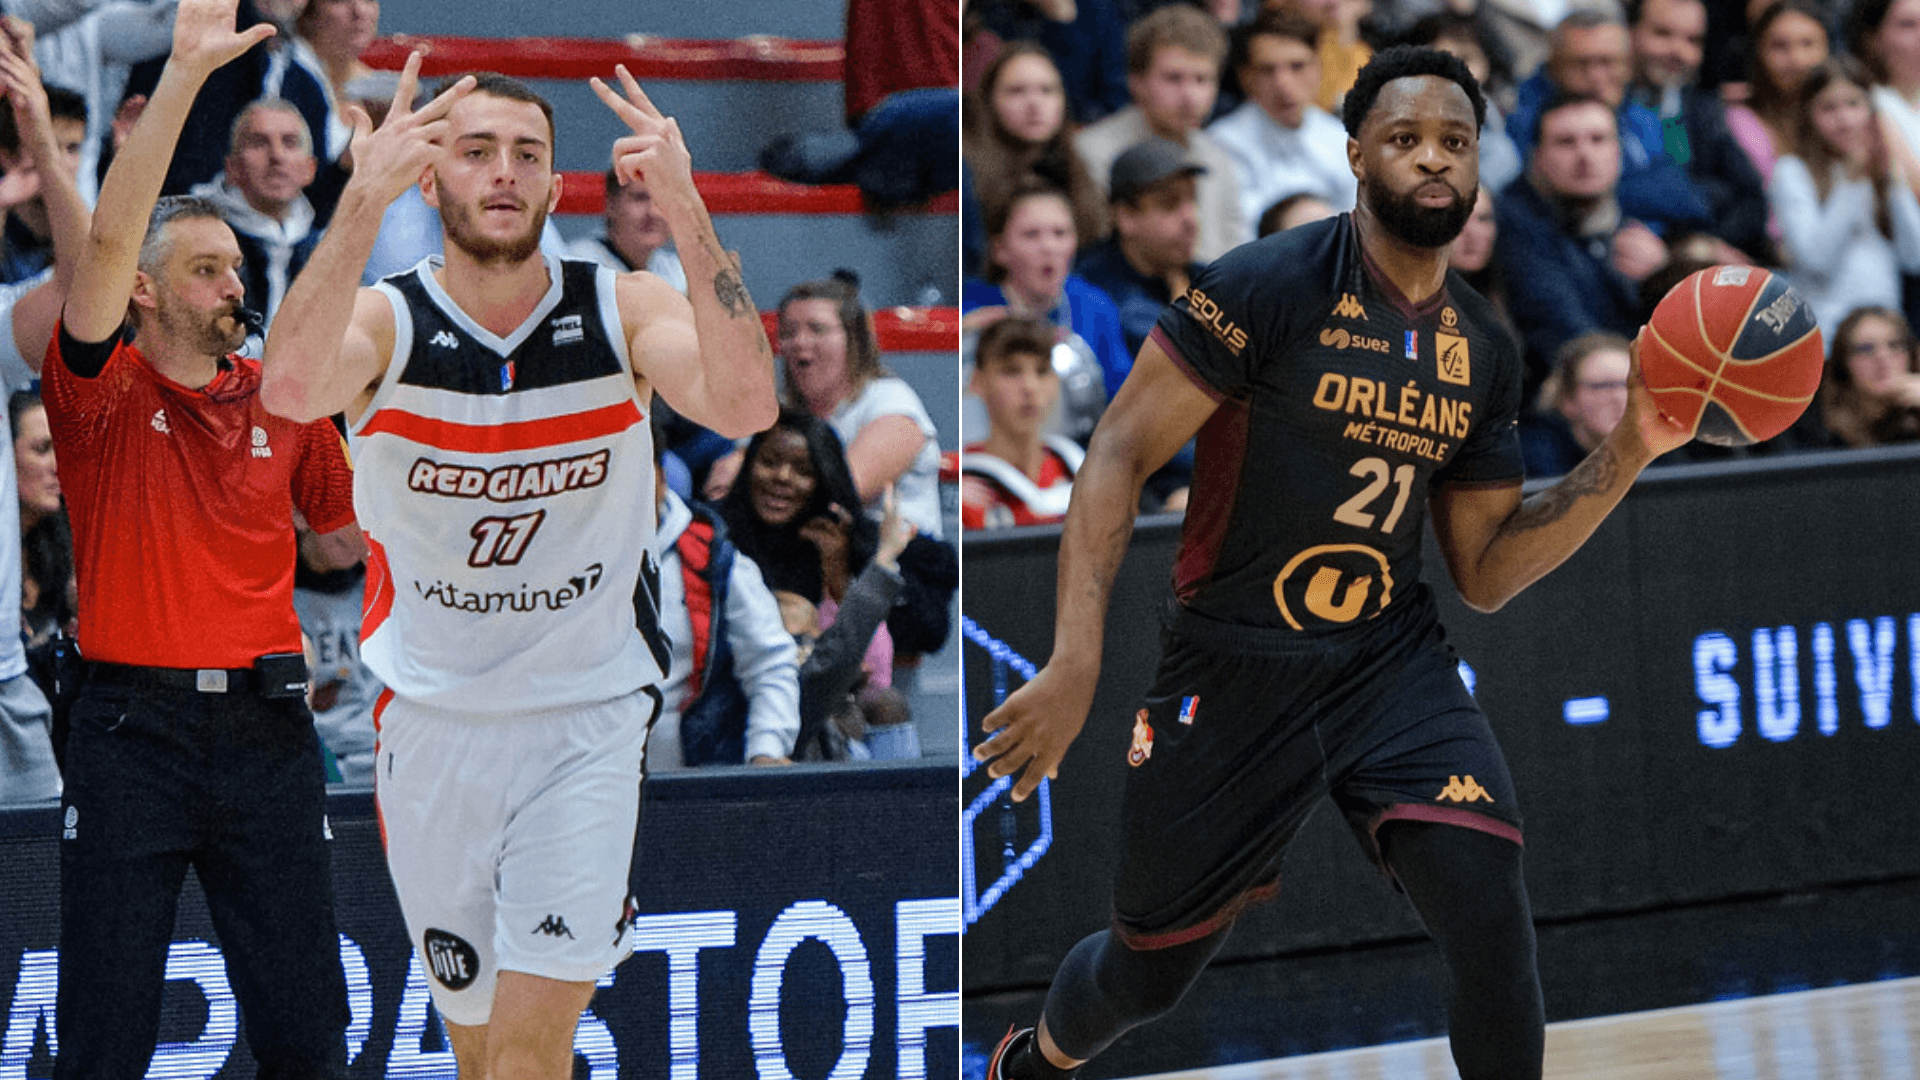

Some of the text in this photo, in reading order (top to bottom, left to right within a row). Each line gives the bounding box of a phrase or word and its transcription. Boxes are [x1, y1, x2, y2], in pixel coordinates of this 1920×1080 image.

[1312, 371, 1473, 439] ORLÉANS
[1342, 420, 1450, 461] MÉTROPOLE
[1332, 456, 1416, 534] 21
